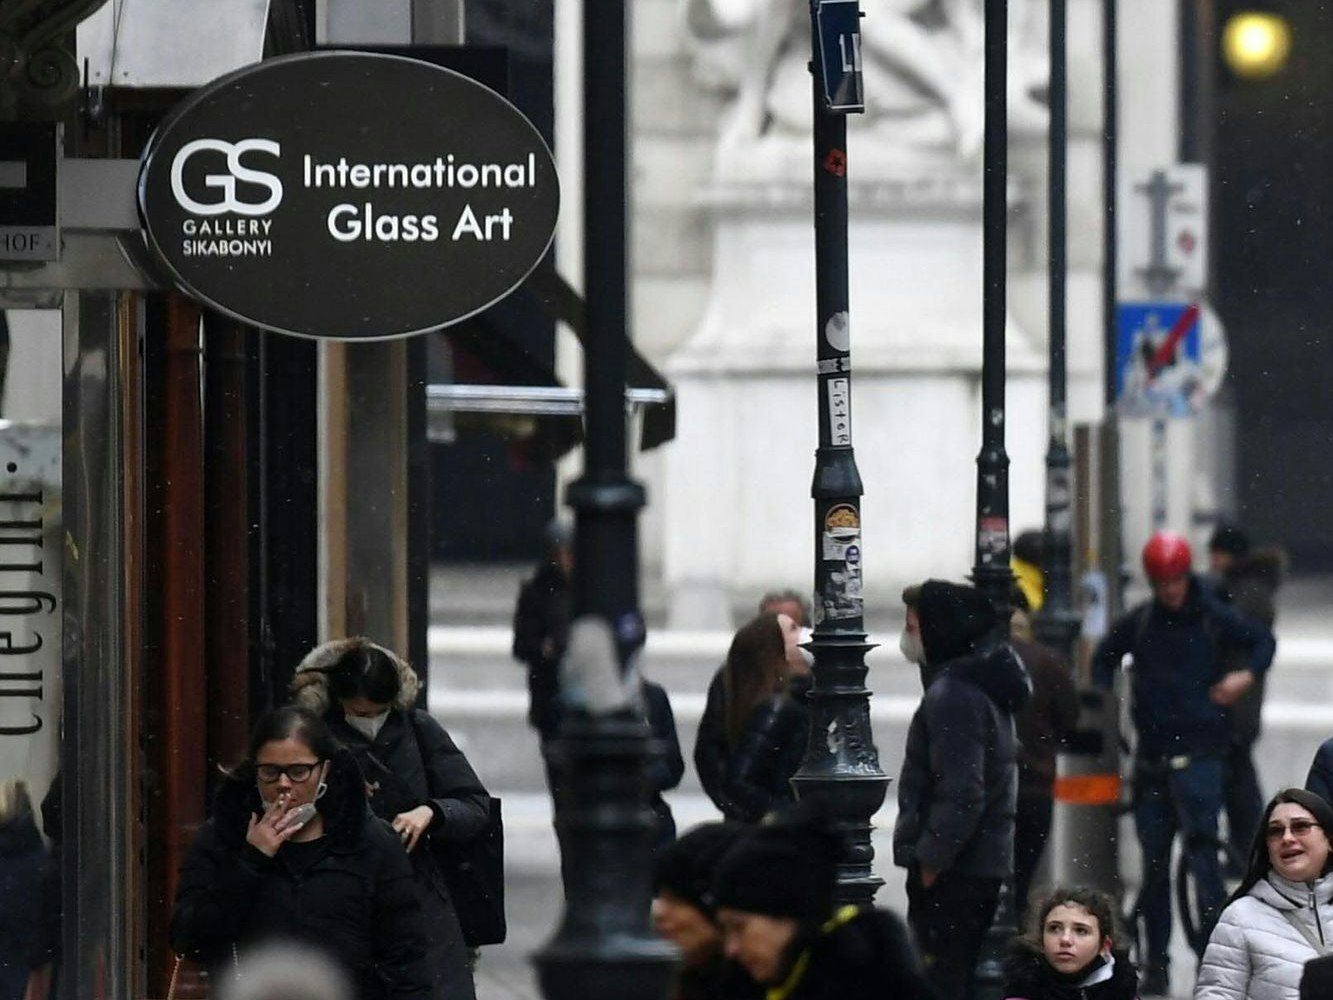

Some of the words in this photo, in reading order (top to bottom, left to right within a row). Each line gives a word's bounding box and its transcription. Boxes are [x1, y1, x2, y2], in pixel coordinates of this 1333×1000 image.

[171, 138, 284, 215] GS
[304, 152, 536, 188] International
[182, 219, 273, 236] GALLERY
[327, 202, 439, 242] Glass
[452, 203, 514, 242] Art
[182, 240, 272, 256] SIKABONYI
